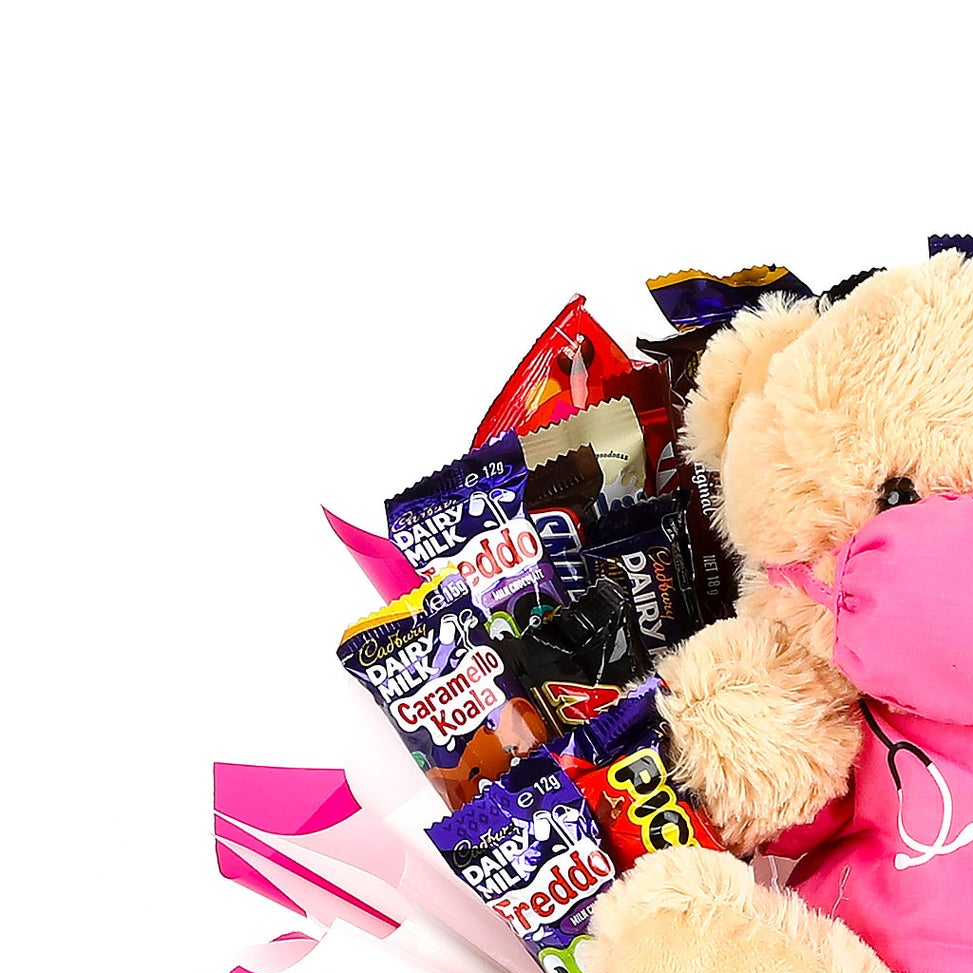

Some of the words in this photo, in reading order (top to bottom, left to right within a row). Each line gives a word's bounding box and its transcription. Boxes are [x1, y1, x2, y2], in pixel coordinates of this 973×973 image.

[482, 461, 505, 479] 12g
[393, 503, 464, 551] DAIRY
[403, 525, 467, 568] MILK
[419, 528, 538, 586] eddo
[621, 551, 666, 642] DAIRY
[646, 545, 676, 621] Cadbury
[358, 624, 427, 667] Cadbury
[365, 629, 435, 687] DAIRY
[378, 657, 439, 704] MILK
[397, 651, 499, 725] Caramello
[430, 687, 498, 737] Koala
[533, 774, 561, 796] 12g
[461, 824, 529, 887] DAIRY
[476, 861, 537, 900] MILK
[492, 850, 612, 930] Freddo
